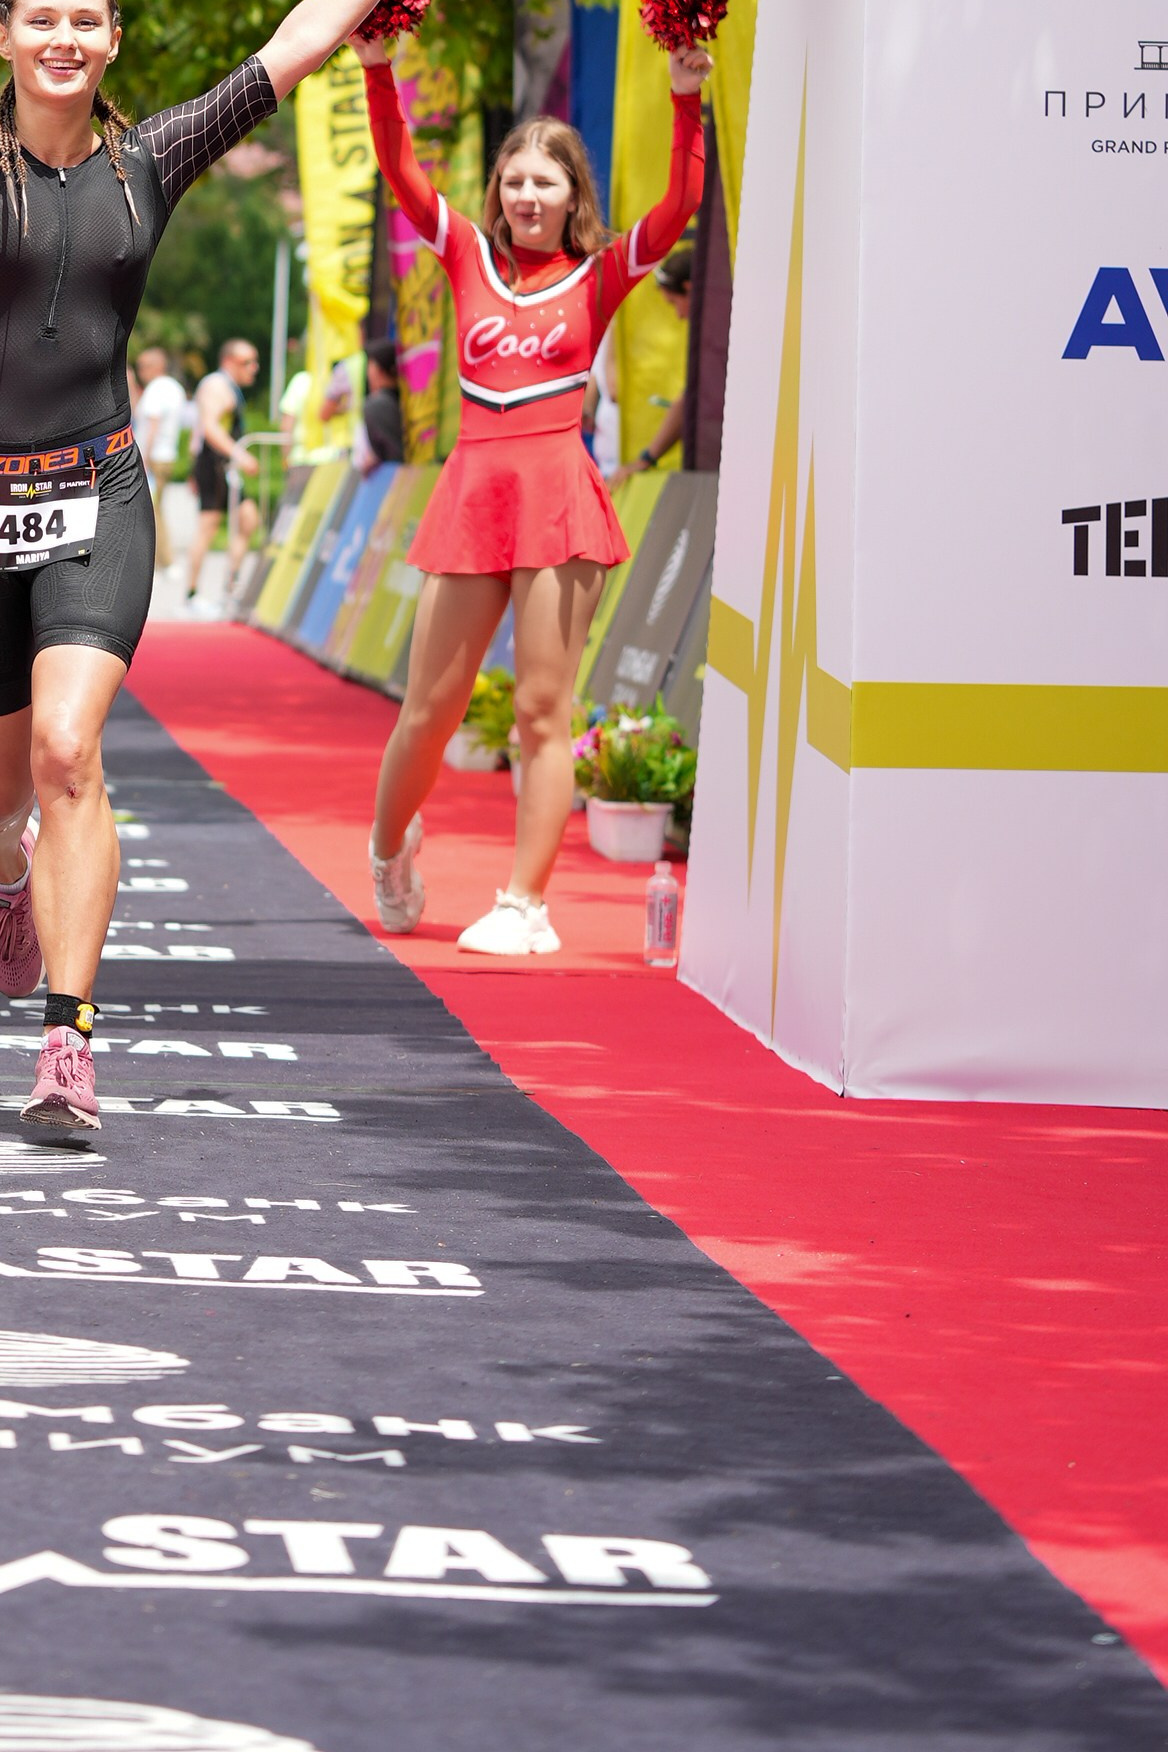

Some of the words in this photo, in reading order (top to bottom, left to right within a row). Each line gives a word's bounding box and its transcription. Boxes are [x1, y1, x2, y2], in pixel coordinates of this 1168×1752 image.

[1045, 90, 1168, 119] ПРИ
[1091, 139, 1157, 154] GRAND
[464, 315, 567, 365] Cool
[15, 550, 51, 565] MARIYA
[37, 1247, 484, 1288] STAR
[101, 1513, 714, 1590] STAR
